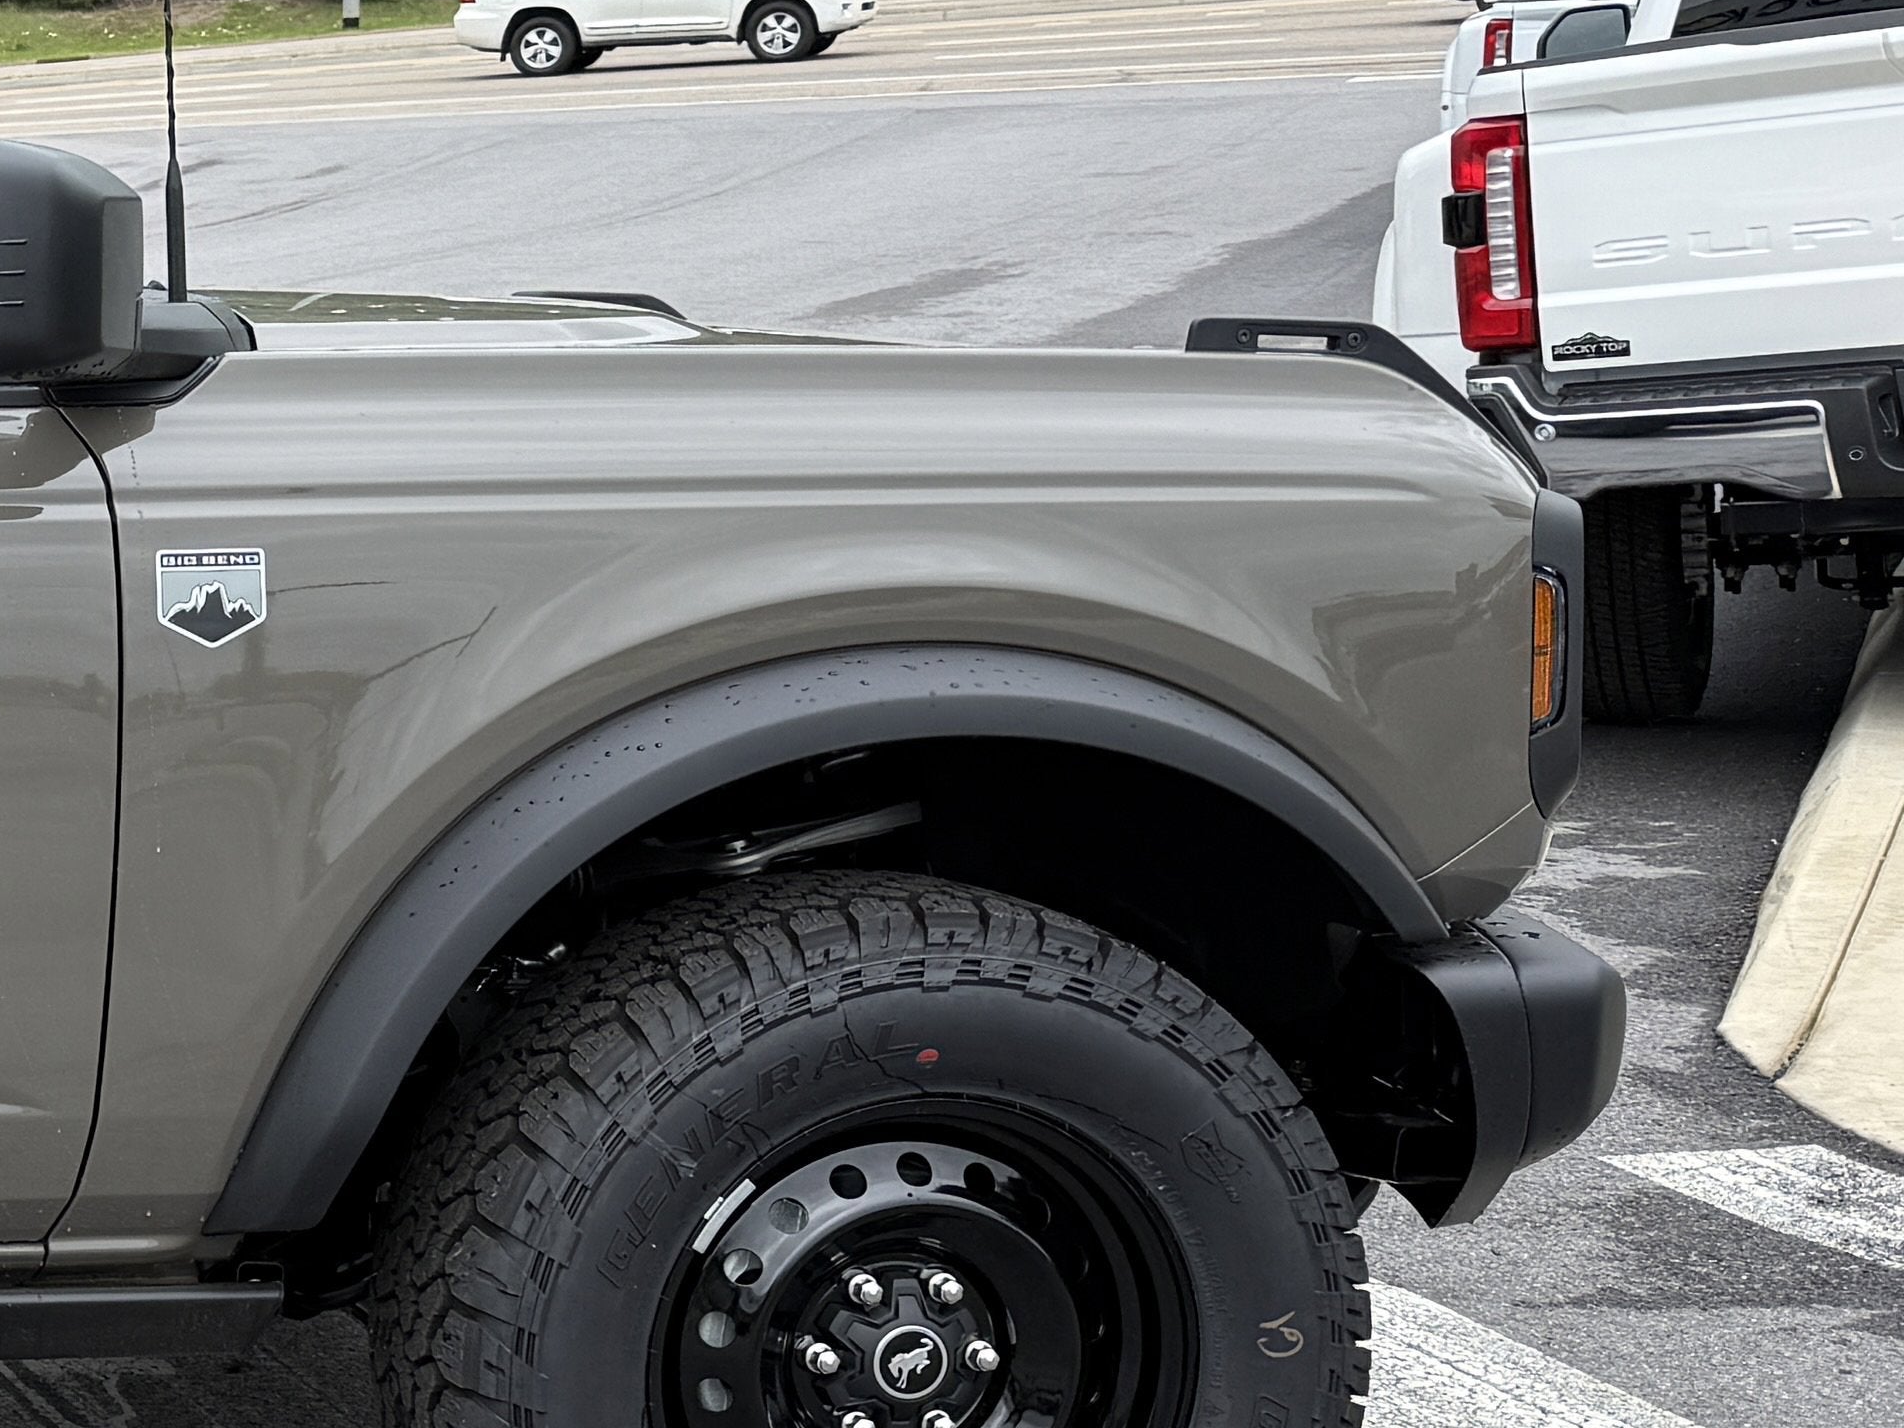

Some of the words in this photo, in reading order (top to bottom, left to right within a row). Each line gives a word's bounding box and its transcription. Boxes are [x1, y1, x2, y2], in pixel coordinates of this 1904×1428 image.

[1592, 215, 1904, 269] SUP
[1553, 344, 1597, 355] ROCKY
[1600, 342, 1627, 352] TOP
[162, 556, 197, 566] BIG
[202, 555, 260, 565] BEND
[597, 1021, 920, 1289] GENERAL
